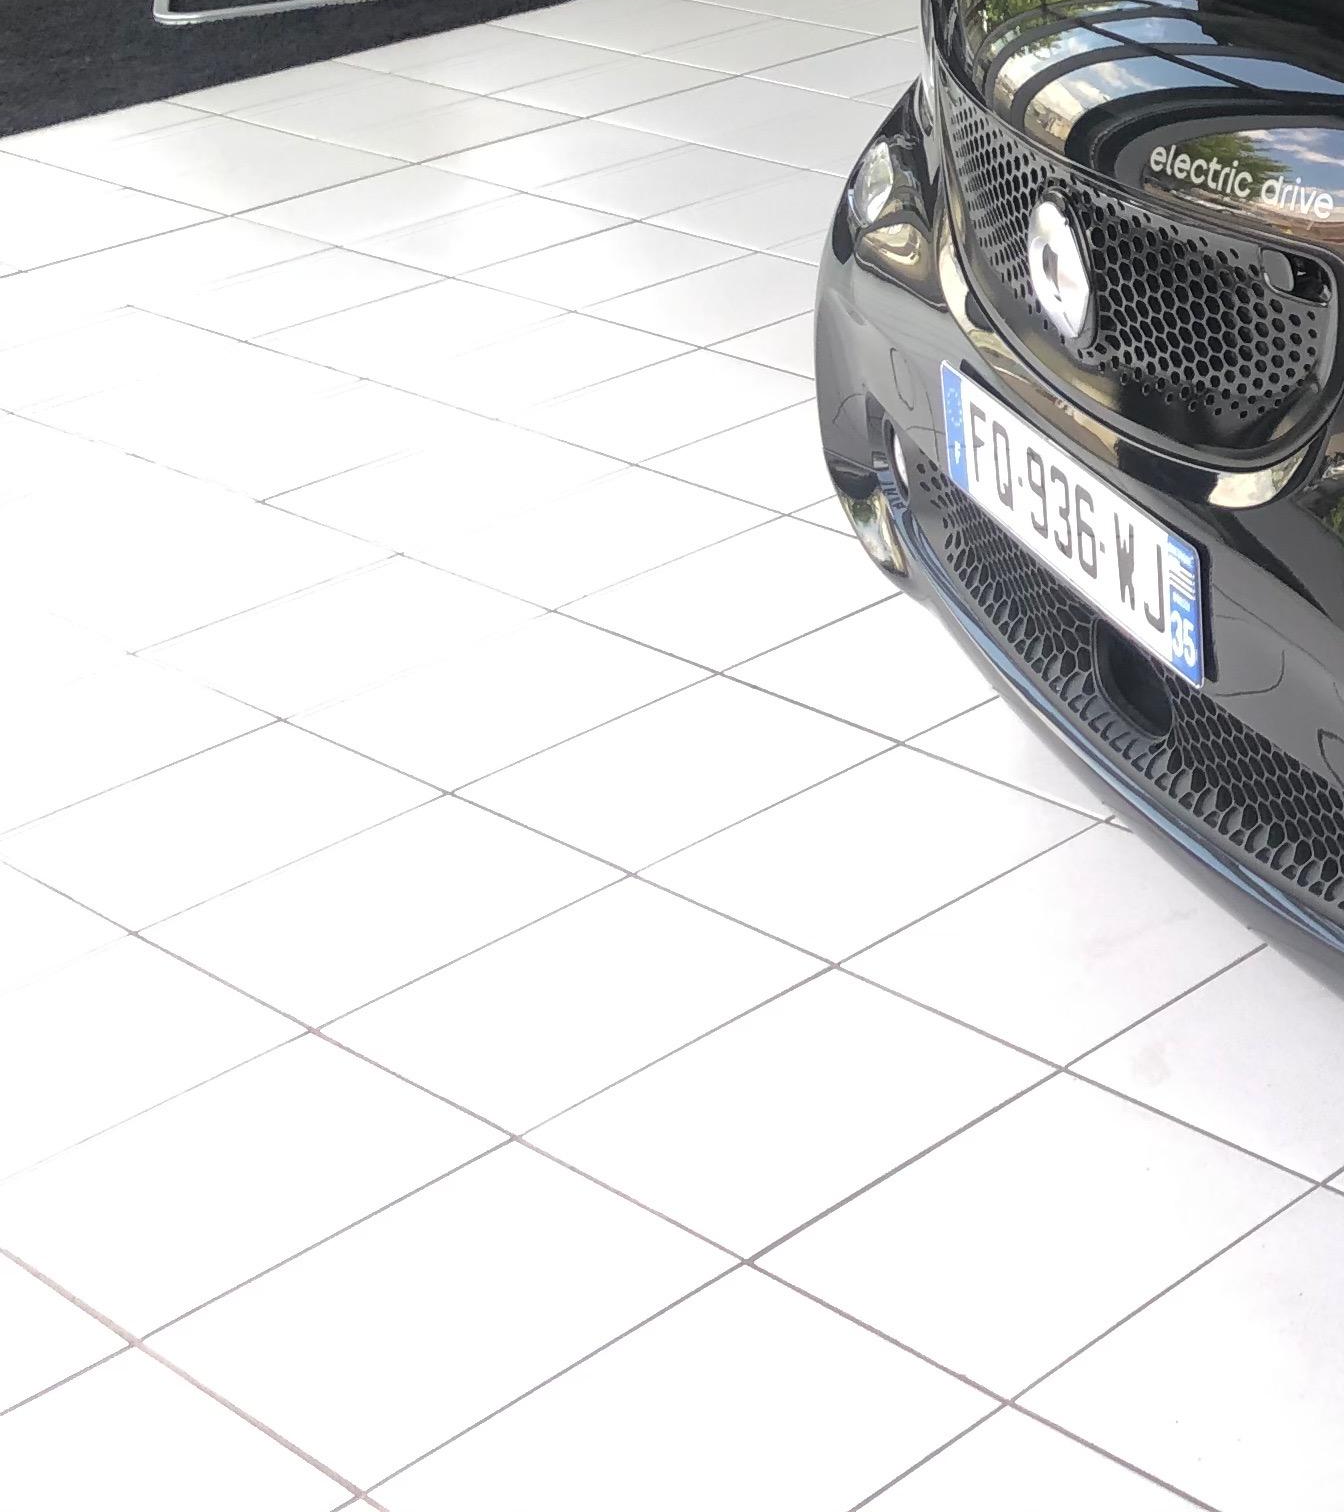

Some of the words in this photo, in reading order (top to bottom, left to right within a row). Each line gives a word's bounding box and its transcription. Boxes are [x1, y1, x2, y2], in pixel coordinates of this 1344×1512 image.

[1150, 144, 1253, 197] electric
[1261, 175, 1334, 219] drive
[1171, 610, 1197, 668] 35
